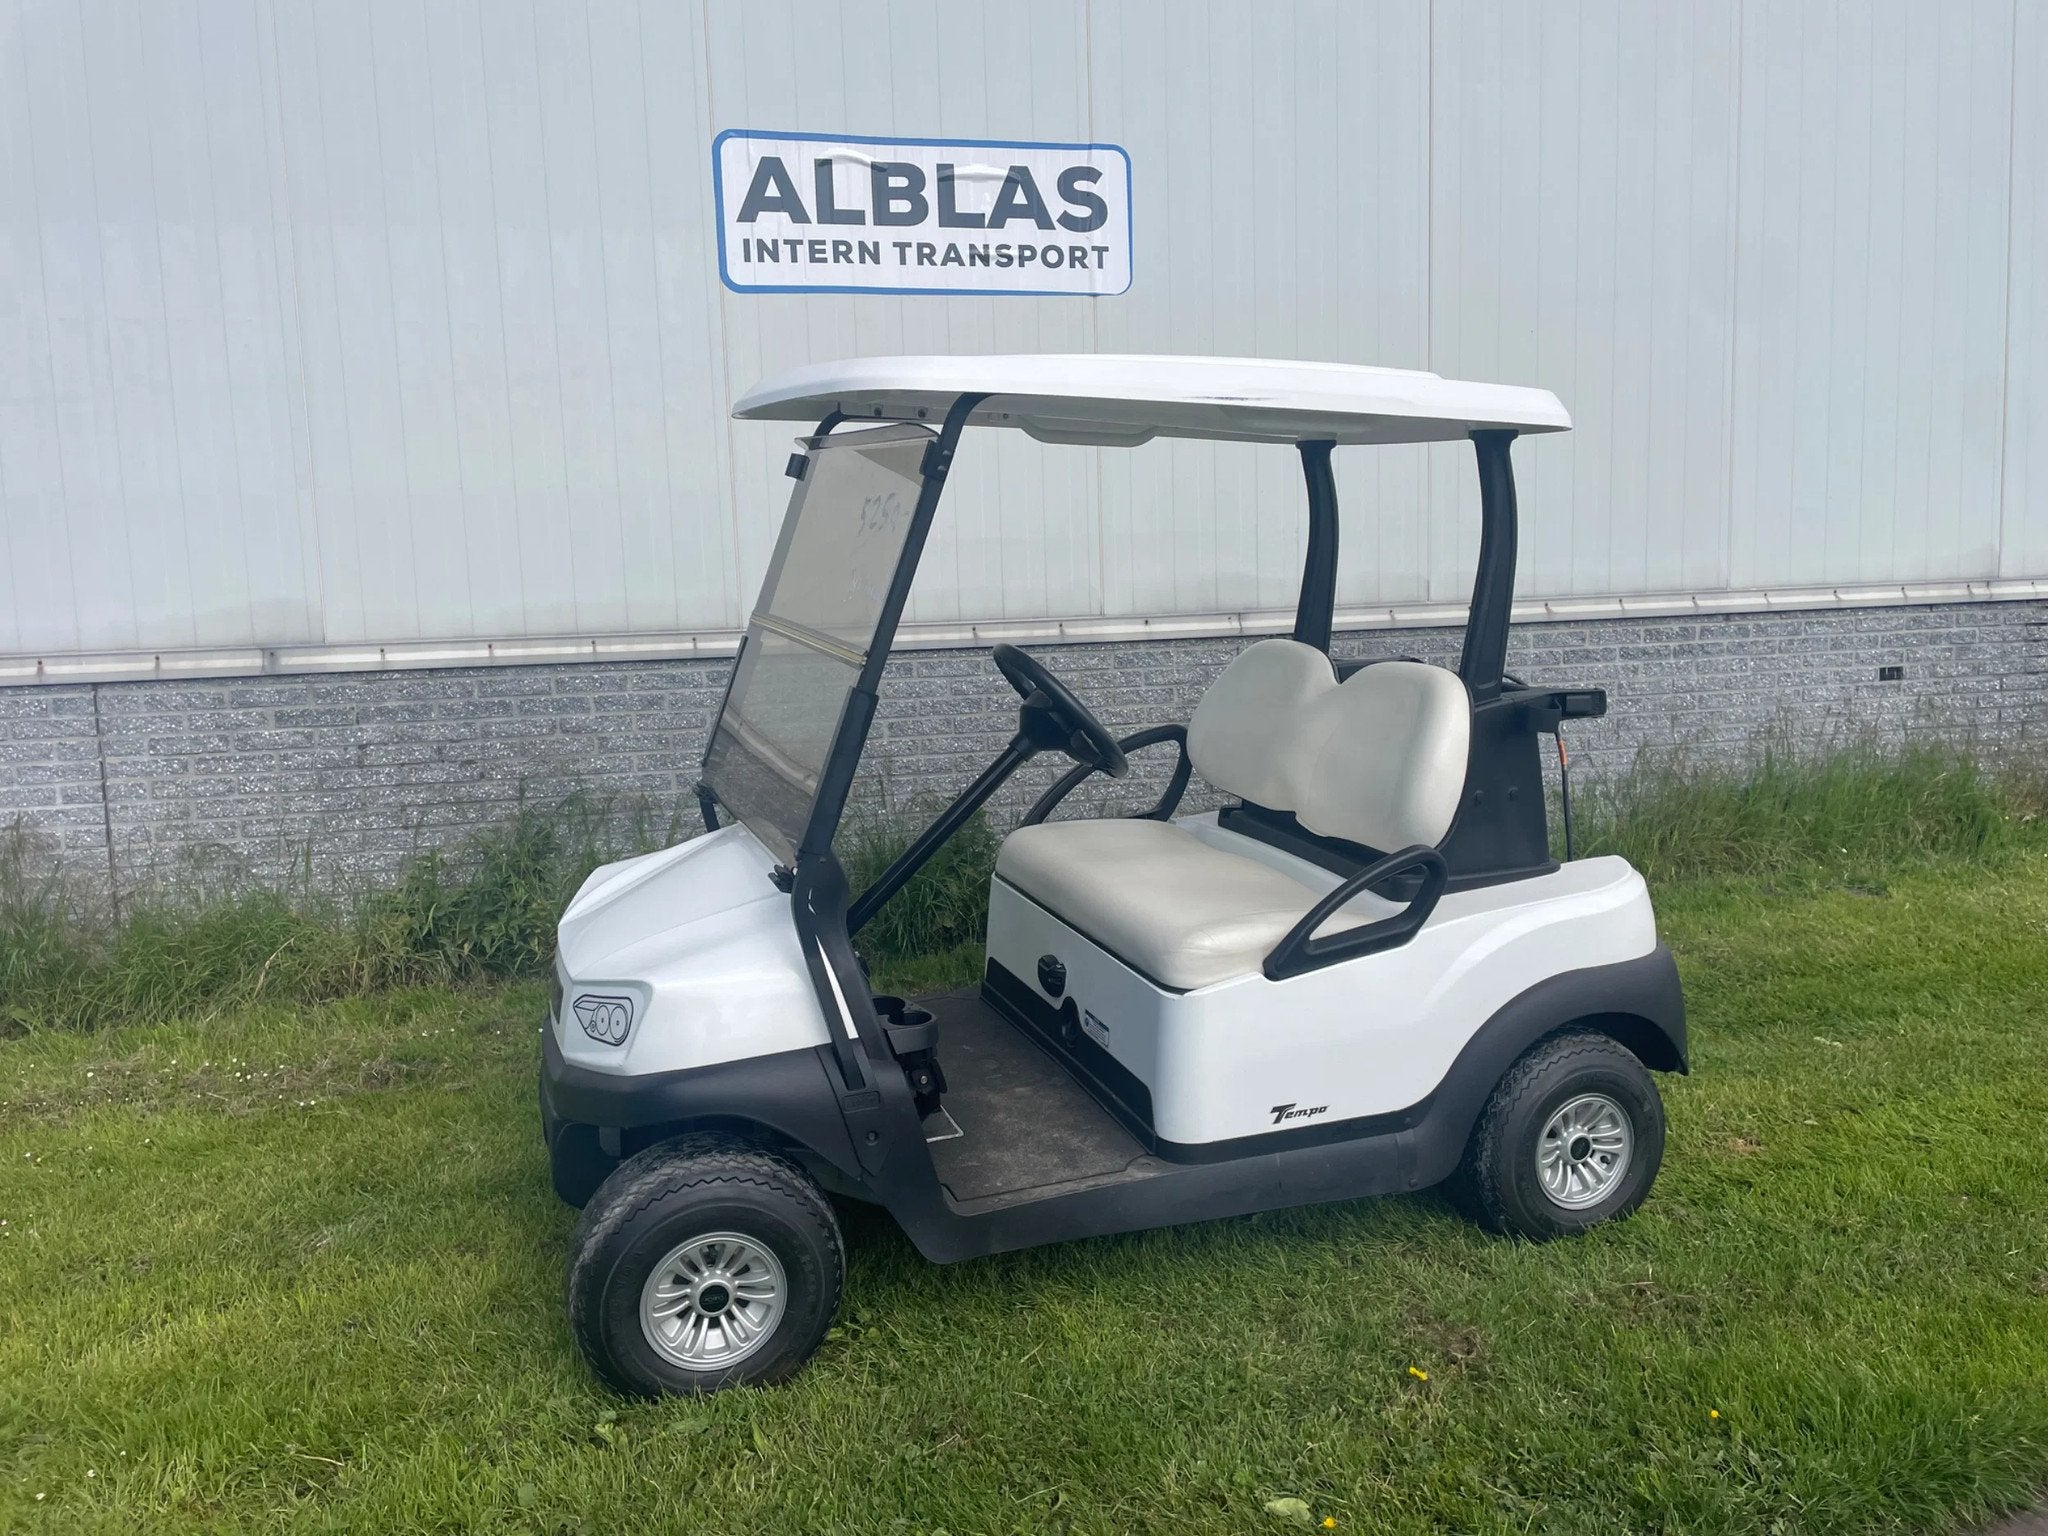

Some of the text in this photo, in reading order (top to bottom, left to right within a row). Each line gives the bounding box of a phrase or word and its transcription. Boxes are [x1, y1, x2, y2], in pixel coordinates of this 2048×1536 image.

[736, 156, 1109, 233] ALBLAS
[743, 238, 1110, 270] INTERN TRANSPORT
[1269, 1102, 1330, 1125] Tempo
